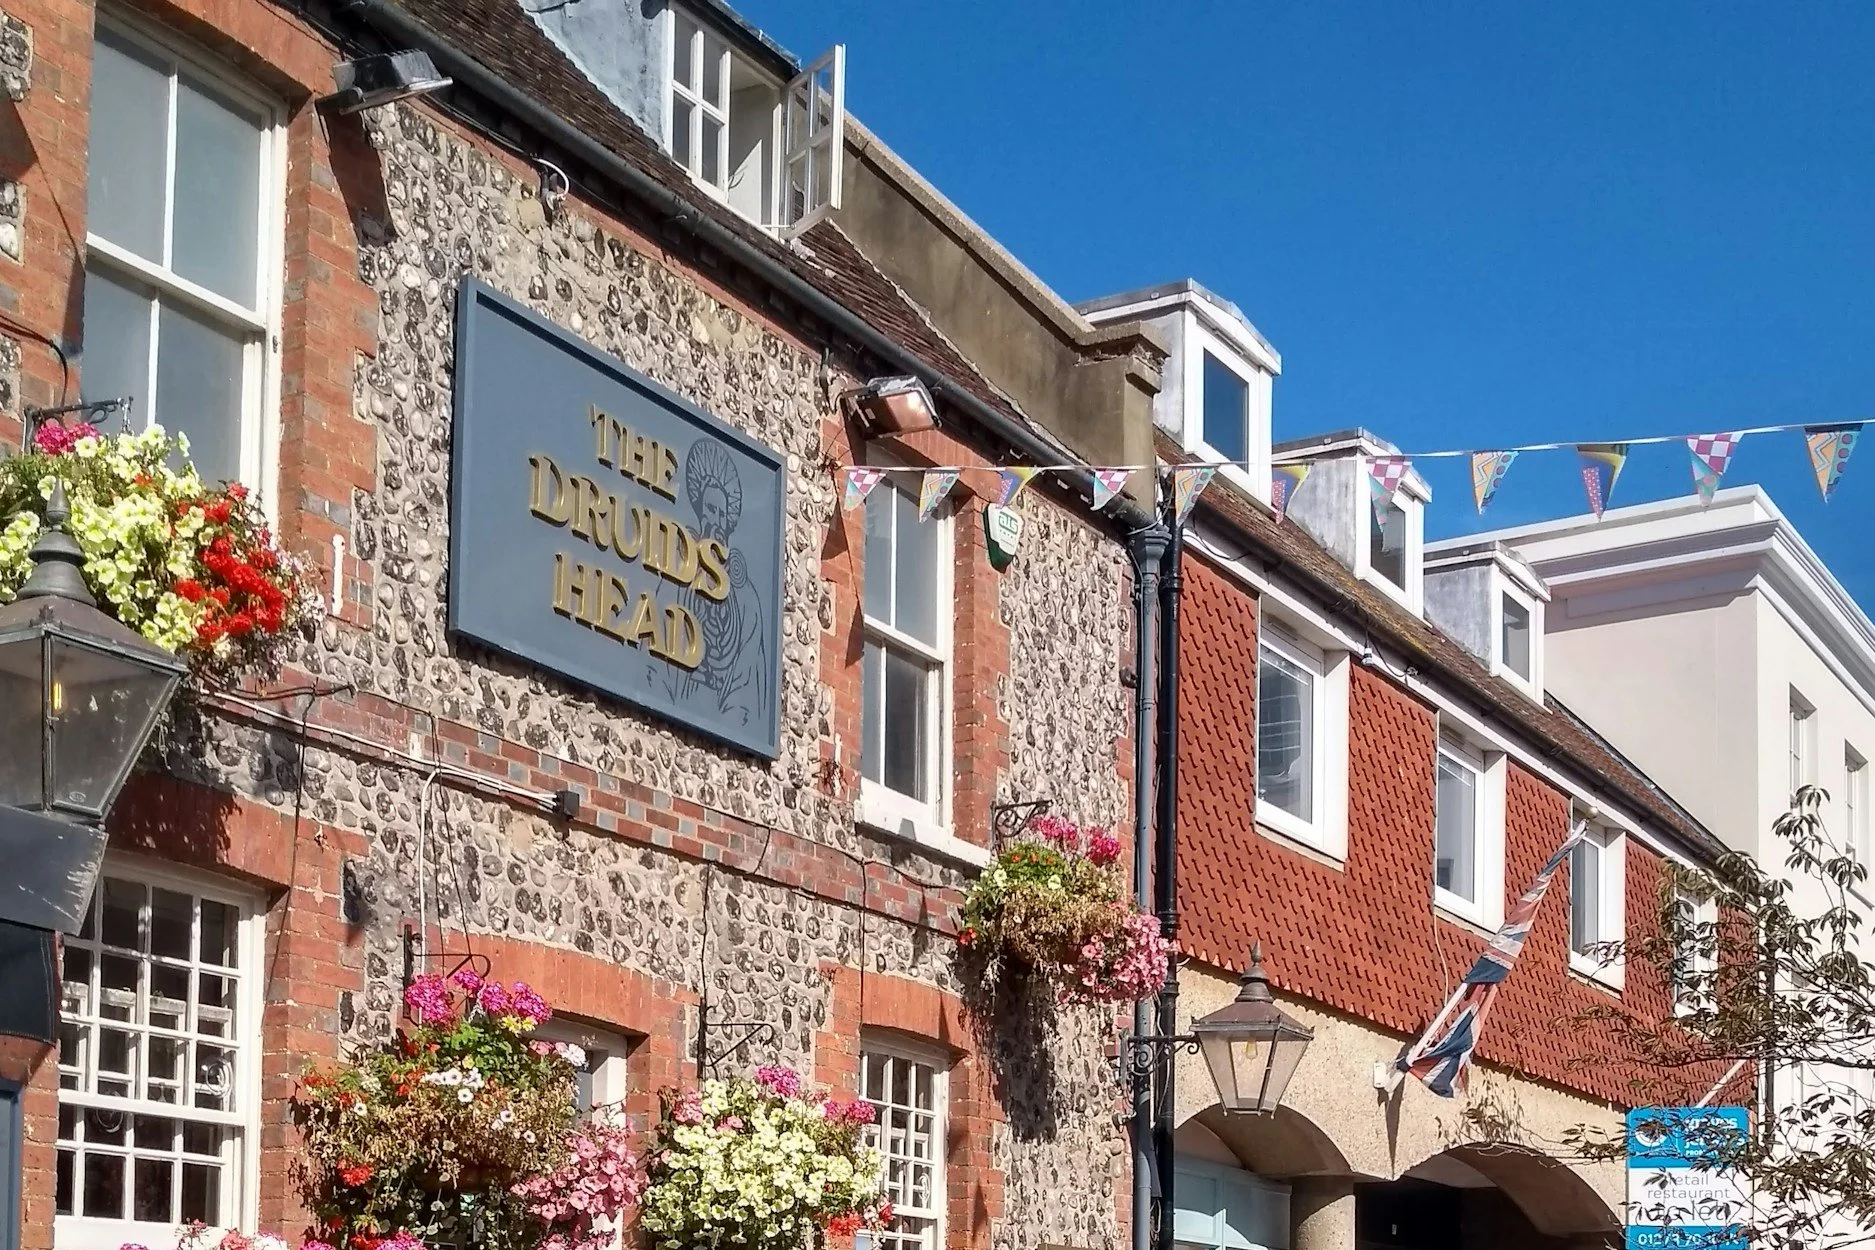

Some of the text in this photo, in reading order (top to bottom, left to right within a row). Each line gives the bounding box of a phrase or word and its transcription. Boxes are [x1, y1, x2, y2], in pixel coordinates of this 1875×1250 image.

[588, 404, 679, 503] THE
[527, 453, 731, 602] DRUIDS
[552, 551, 702, 670] HEAD
[1648, 1188, 1731, 1199] restaurant
